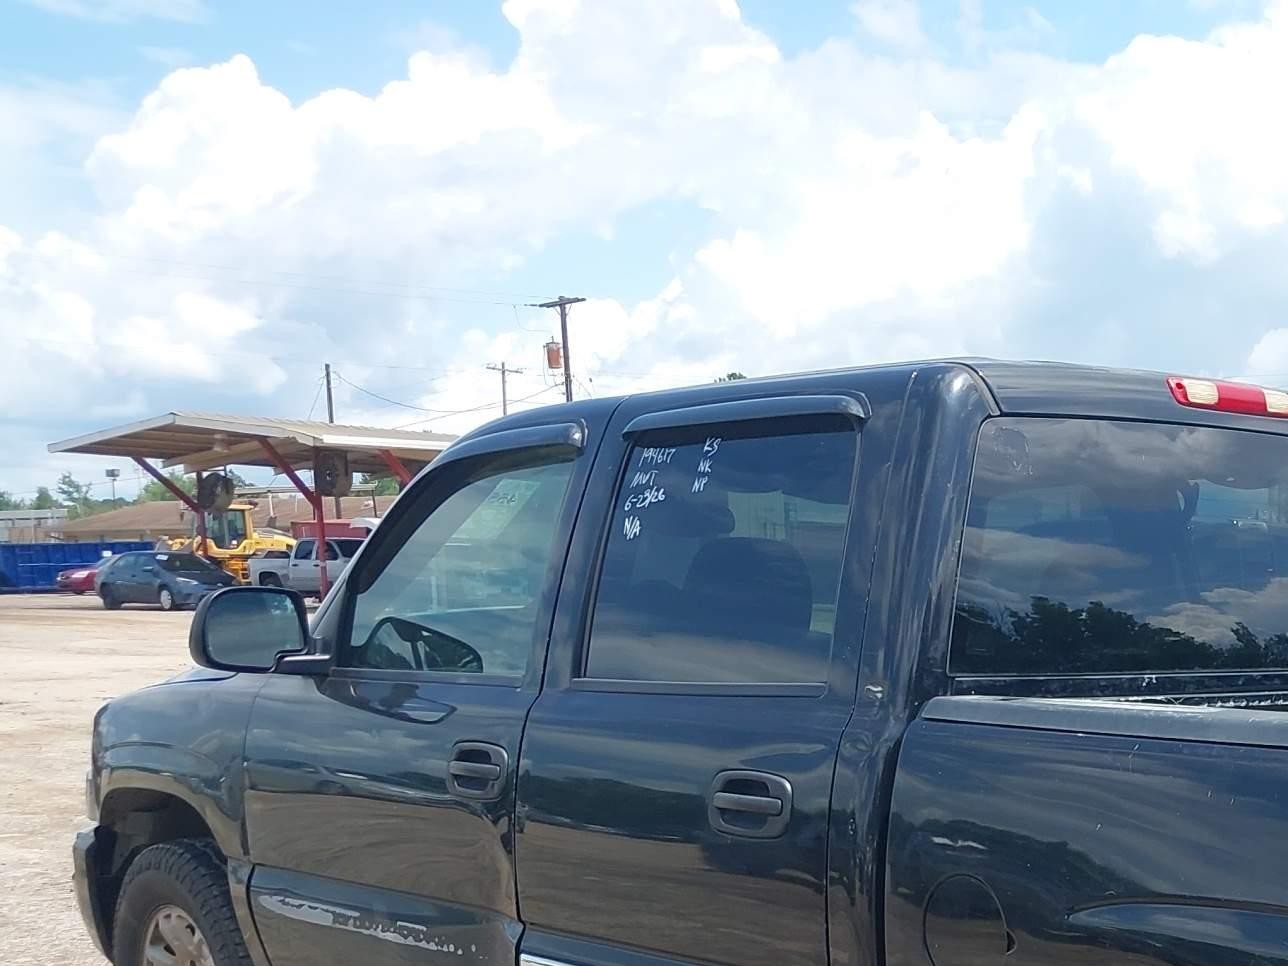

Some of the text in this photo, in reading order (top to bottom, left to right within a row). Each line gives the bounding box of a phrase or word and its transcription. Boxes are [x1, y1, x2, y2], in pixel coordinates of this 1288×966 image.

[638, 447, 676, 468] 194617
[703, 437, 722, 458] KS
[697, 458, 713, 473] NK
[691, 475, 708, 493] NP
[623, 515, 642, 541] N/A
